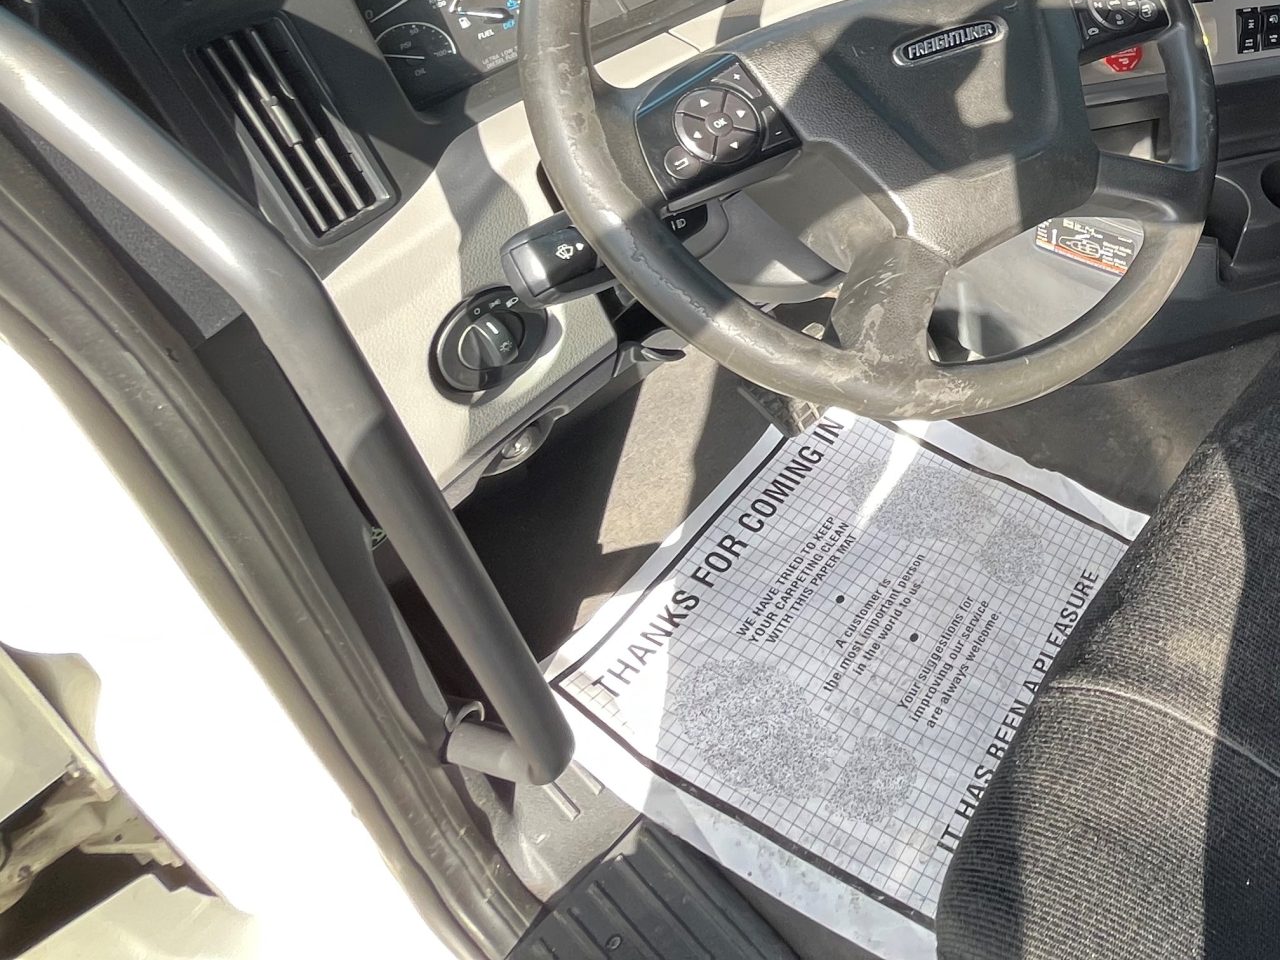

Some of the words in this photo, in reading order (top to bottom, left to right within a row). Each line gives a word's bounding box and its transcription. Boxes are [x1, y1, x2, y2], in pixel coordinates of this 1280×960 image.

[365, 9, 373, 20] 0
[478, 28, 495, 40] FUEL
[908, 23, 994, 59] FREIGHTLINER
[713, 116, 728, 129] OK
[591, 590, 700, 698] THANKS
[690, 534, 749, 588] FOR
[738, 445, 824, 533] COMING
[812, 416, 845, 445] IN
[736, 617, 756, 637] WE
[753, 587, 780, 616] HAVE
[775, 556, 804, 586] TRIED
[801, 542, 816, 555] TO
[814, 516, 834, 541] KEEP
[748, 611, 778, 643] YOUR
[775, 553, 824, 610] CARPETING
[821, 522, 850, 553] CLEAN
[766, 613, 794, 644] WITH
[790, 587, 814, 613] THIS
[811, 554, 841, 587] PAPER
[836, 533, 857, 554] MAT
[835, 639, 847, 649] A
[844, 589, 882, 638] customer
[879, 578, 891, 589] is
[823, 672, 842, 692] the
[840, 640, 865, 670] most
[862, 588, 902, 639] important
[898, 554, 926, 589] person
[852, 663, 867, 676] in
[863, 642, 881, 661] the
[878, 609, 903, 640] world
[898, 597, 911, 608] to
[909, 580, 925, 595] us.
[897, 681, 920, 710] Your
[918, 613, 964, 681] suggestions
[959, 596, 975, 612] for
[909, 662, 954, 723] improving
[949, 640, 964, 660] our
[962, 600, 989, 640] service
[926, 706, 943, 728] are
[941, 663, 969, 704] always
[966, 611, 1002, 662] welcome.
[937, 823, 962, 854] IT
[954, 764, 994, 818] HAS
[986, 698, 1027, 761] BEEN
[1023, 680, 1040, 693] A
[1032, 569, 1099, 674] PLEASURE
